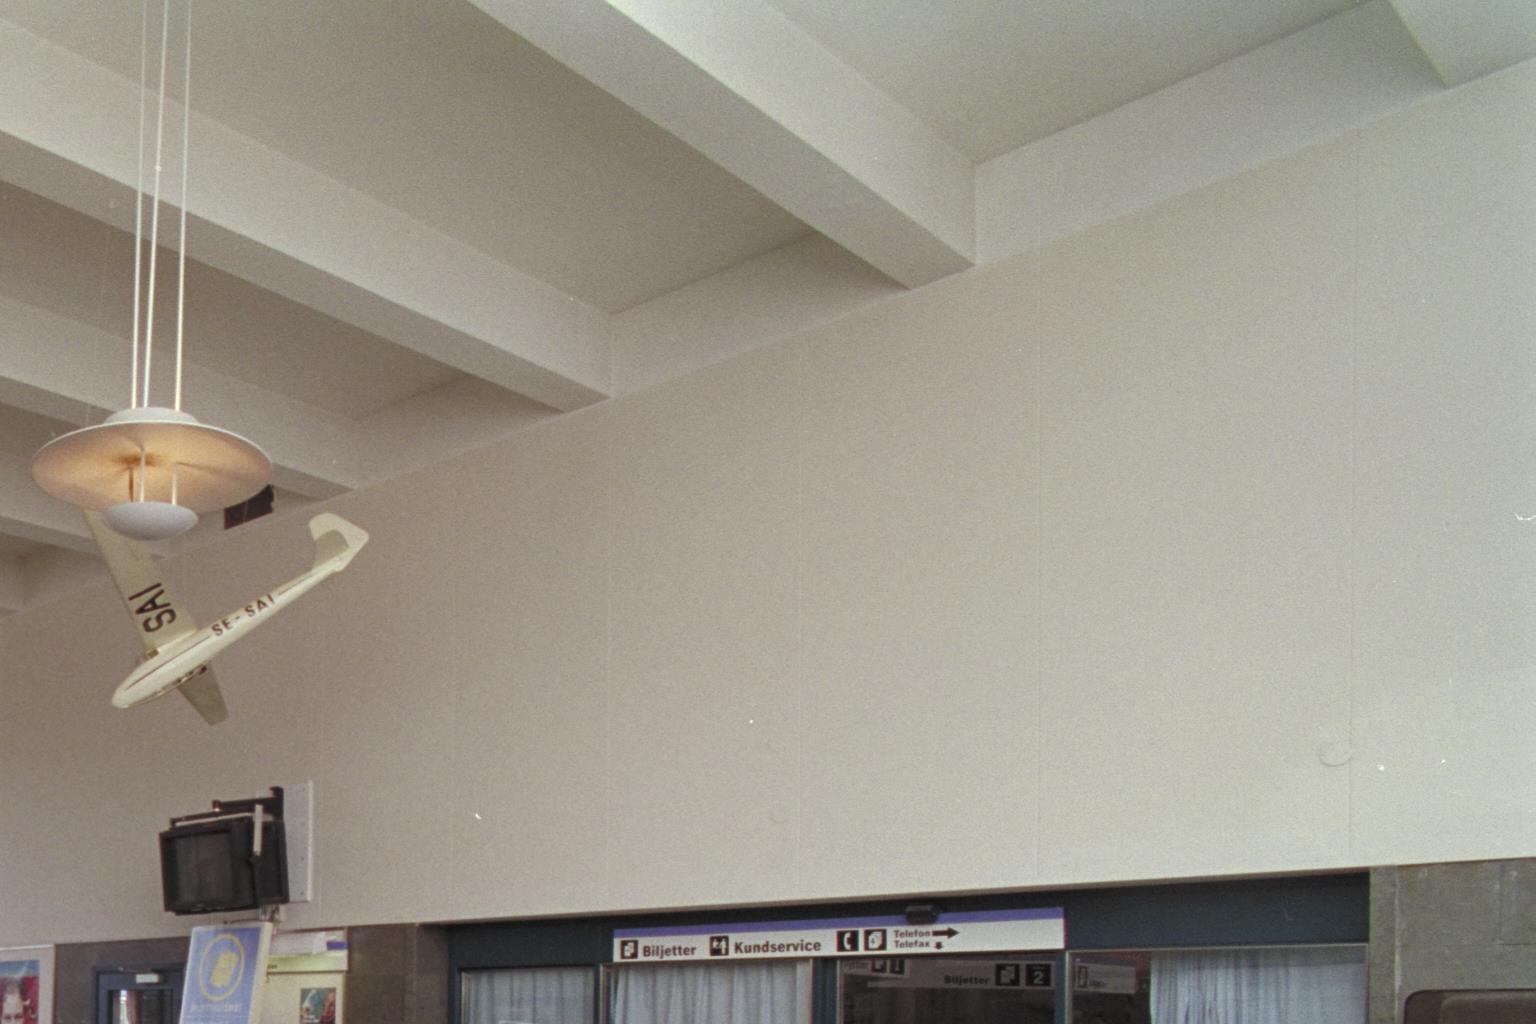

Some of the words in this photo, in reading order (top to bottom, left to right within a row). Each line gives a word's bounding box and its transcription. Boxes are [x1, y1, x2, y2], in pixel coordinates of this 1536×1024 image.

[128, 582, 177, 633] SAI
[893, 929, 931, 939] Telefon
[642, 944, 697, 959] Biljetter
[734, 939, 822, 954] Kundservice
[893, 940, 930, 949] Telefax
[943, 974, 990, 987] Biljetter
[1032, 971, 1043, 985] 2
